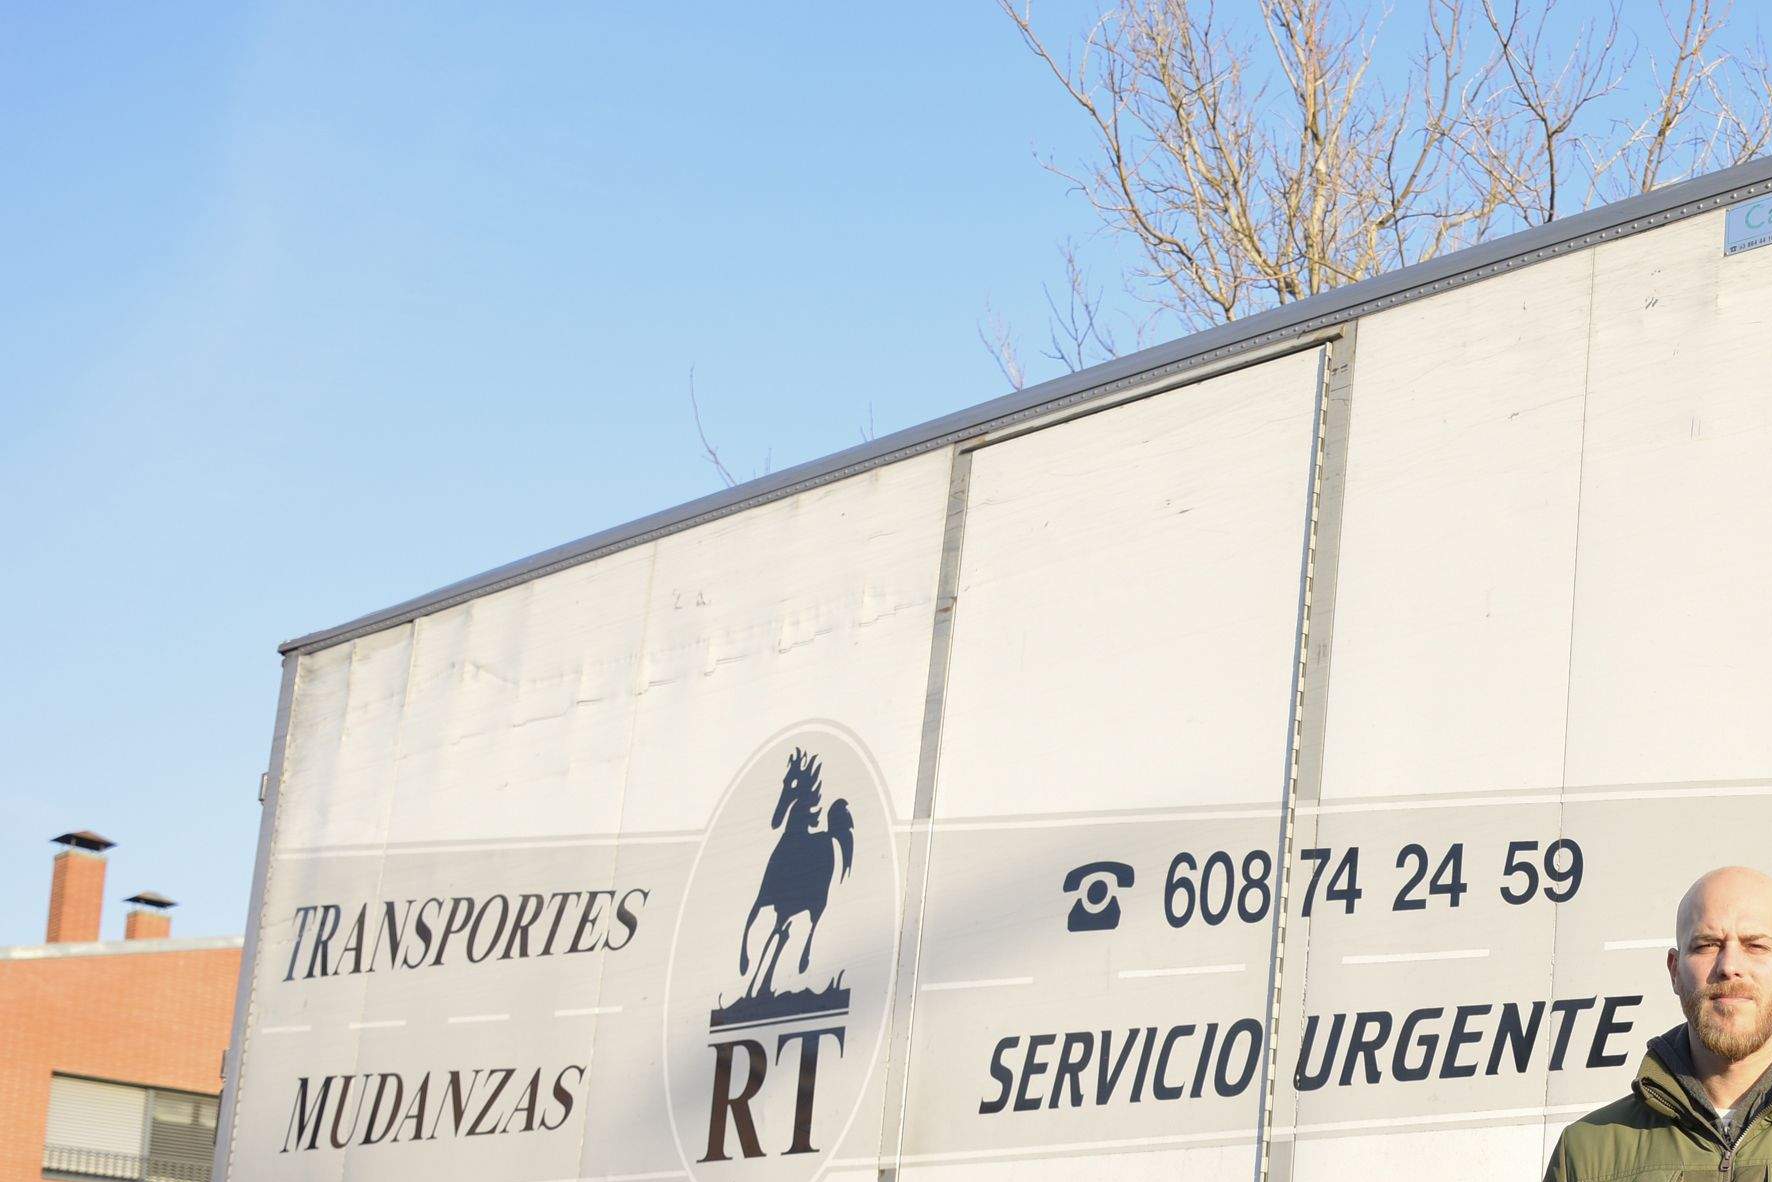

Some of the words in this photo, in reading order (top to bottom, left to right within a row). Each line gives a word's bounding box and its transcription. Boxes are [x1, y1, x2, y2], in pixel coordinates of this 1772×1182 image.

[1163, 850, 1272, 929] 608
[1300, 846, 1362, 918] 74
[1392, 843, 1467, 912] 24
[1500, 838, 1584, 905] 59
[282, 888, 650, 982] TRANSPORTES
[696, 1025, 845, 1165] RT
[978, 1018, 1263, 1115] SERVICIO
[1294, 995, 1644, 1092] URGENTE
[279, 1064, 586, 1154] MUDANZAS
